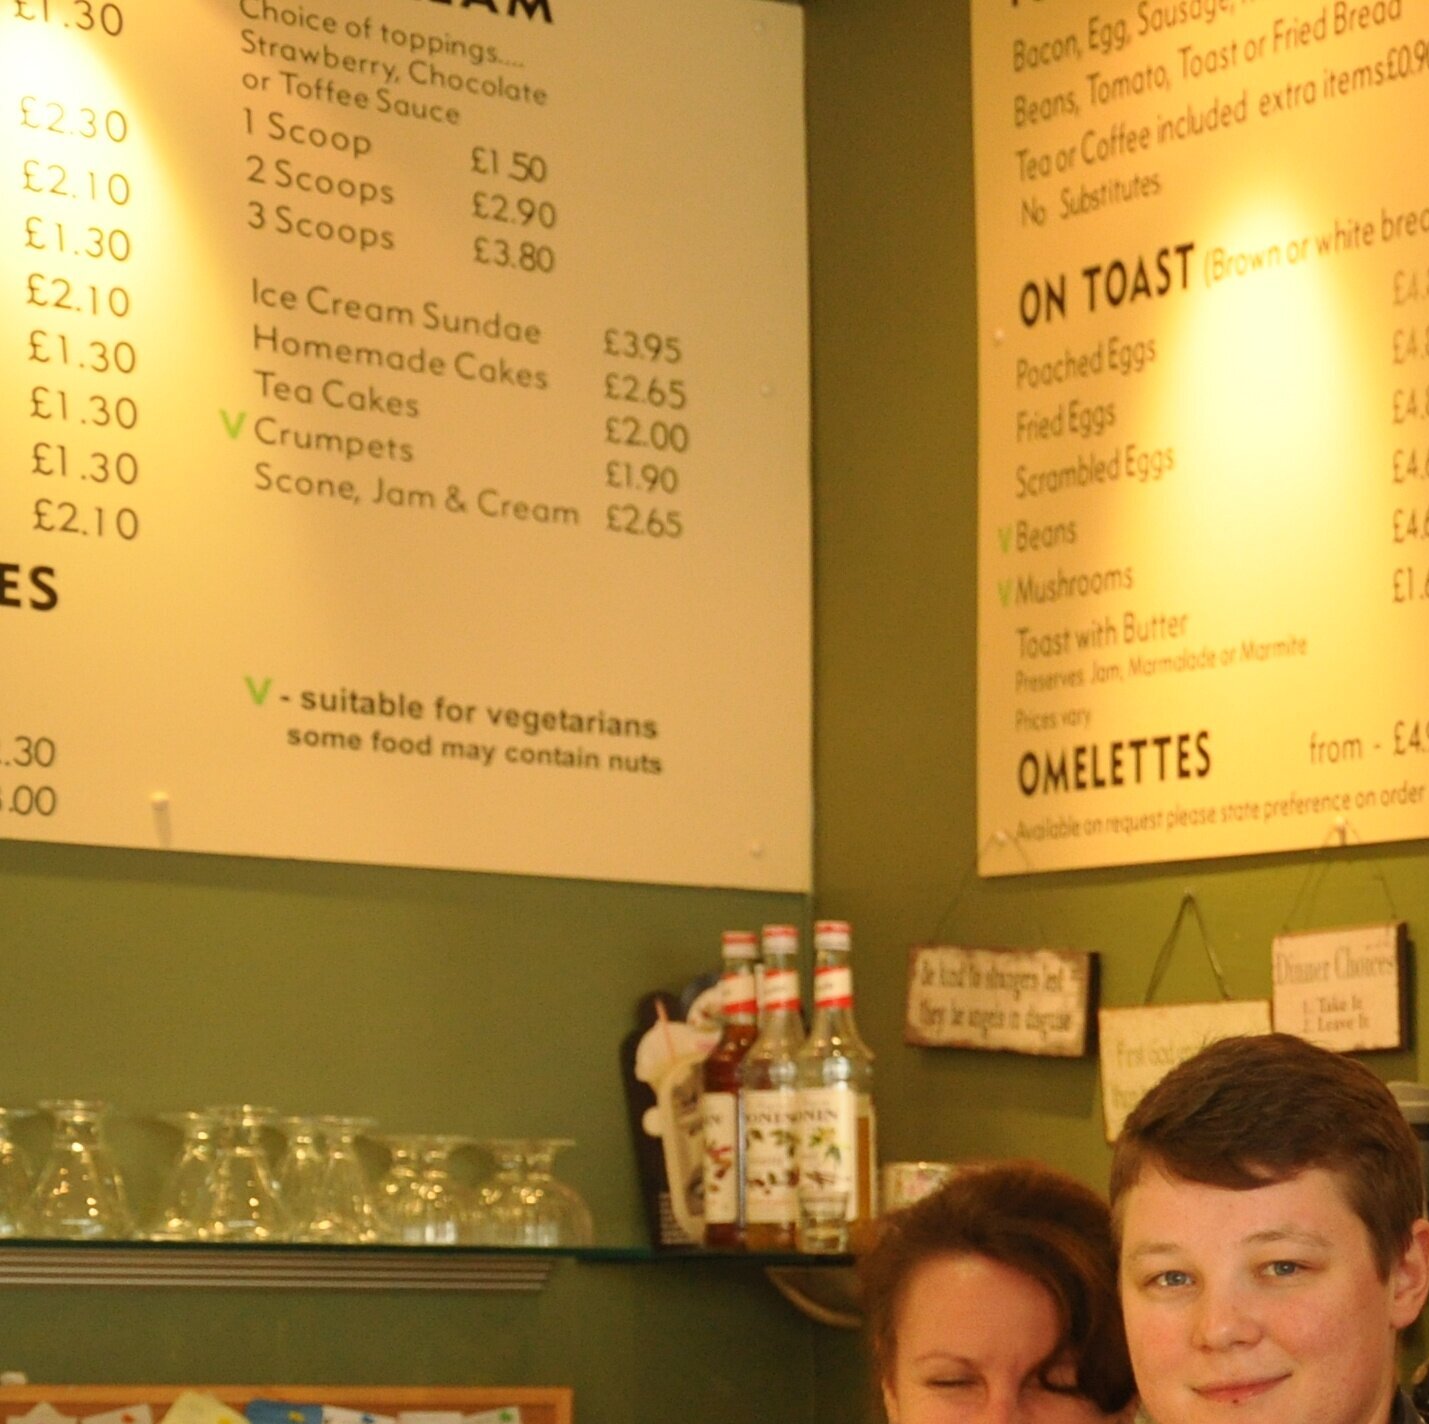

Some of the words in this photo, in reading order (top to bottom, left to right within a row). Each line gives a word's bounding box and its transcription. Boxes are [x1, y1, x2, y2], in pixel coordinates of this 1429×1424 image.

[239, 0, 340, 36] Choice
[345, 14, 373, 40] of
[240, 29, 402, 84] Strawberry,
[407, 60, 549, 107] Chocolate
[1012, 30, 1084, 74] Bacon,
[18, 95, 128, 145] £2.30
[241, 69, 272, 93] or
[279, 73, 372, 110] Toffee
[376, 88, 460, 126] Sauce
[268, 110, 373, 157] Scoop
[21, 160, 132, 208] £2.10
[274, 158, 394, 206] Scoops
[470, 193, 556, 232] £2.90
[23, 216, 132, 264] £1.30
[276, 204, 394, 252] Scoops
[473, 237, 555, 275] £3.80
[26, 272, 132, 320] £2.10
[1019, 274, 1067, 327] ON
[1083, 242, 1195, 313] TOAST
[252, 279, 297, 310] Ice
[306, 285, 413, 327] Cream
[423, 302, 542, 346] Sundae
[602, 329, 682, 365] £3.95
[27, 329, 137, 376] £1.30
[254, 326, 446, 377] Homemade
[454, 353, 549, 392] Cakes
[604, 374, 686, 412] £2.65
[1016, 348, 1103, 390] Poached
[1107, 335, 1157, 376] Eggs
[30, 387, 139, 433] £1.30
[254, 370, 313, 405] Tea
[322, 379, 420, 420] Cakes
[31, 443, 139, 486] £1.30
[254, 416, 414, 464] Crumpets
[604, 416, 689, 454] £2.00
[254, 463, 360, 504] Scone,
[372, 478, 436, 510] Jam
[478, 489, 580, 527] Cream
[605, 460, 678, 497] £1.90
[1015, 449, 1121, 498] Scrambled
[1125, 444, 1175, 480] Eggs
[32, 499, 140, 541] £2.10
[605, 503, 684, 539] £2.65
[1015, 517, 1077, 552] Beans
[1015, 564, 1133, 606] Mushrooms
[302, 686, 423, 721] suitable
[435, 696, 477, 724] for
[486, 702, 658, 740] vegetarians
[287, 724, 361, 753] some
[371, 731, 431, 757] food
[441, 738, 495, 766] may
[505, 744, 599, 771] contain
[608, 750, 663, 776] nuts
[1018, 730, 1211, 797] OMELETTES
[1311, 730, 1363, 766] from
